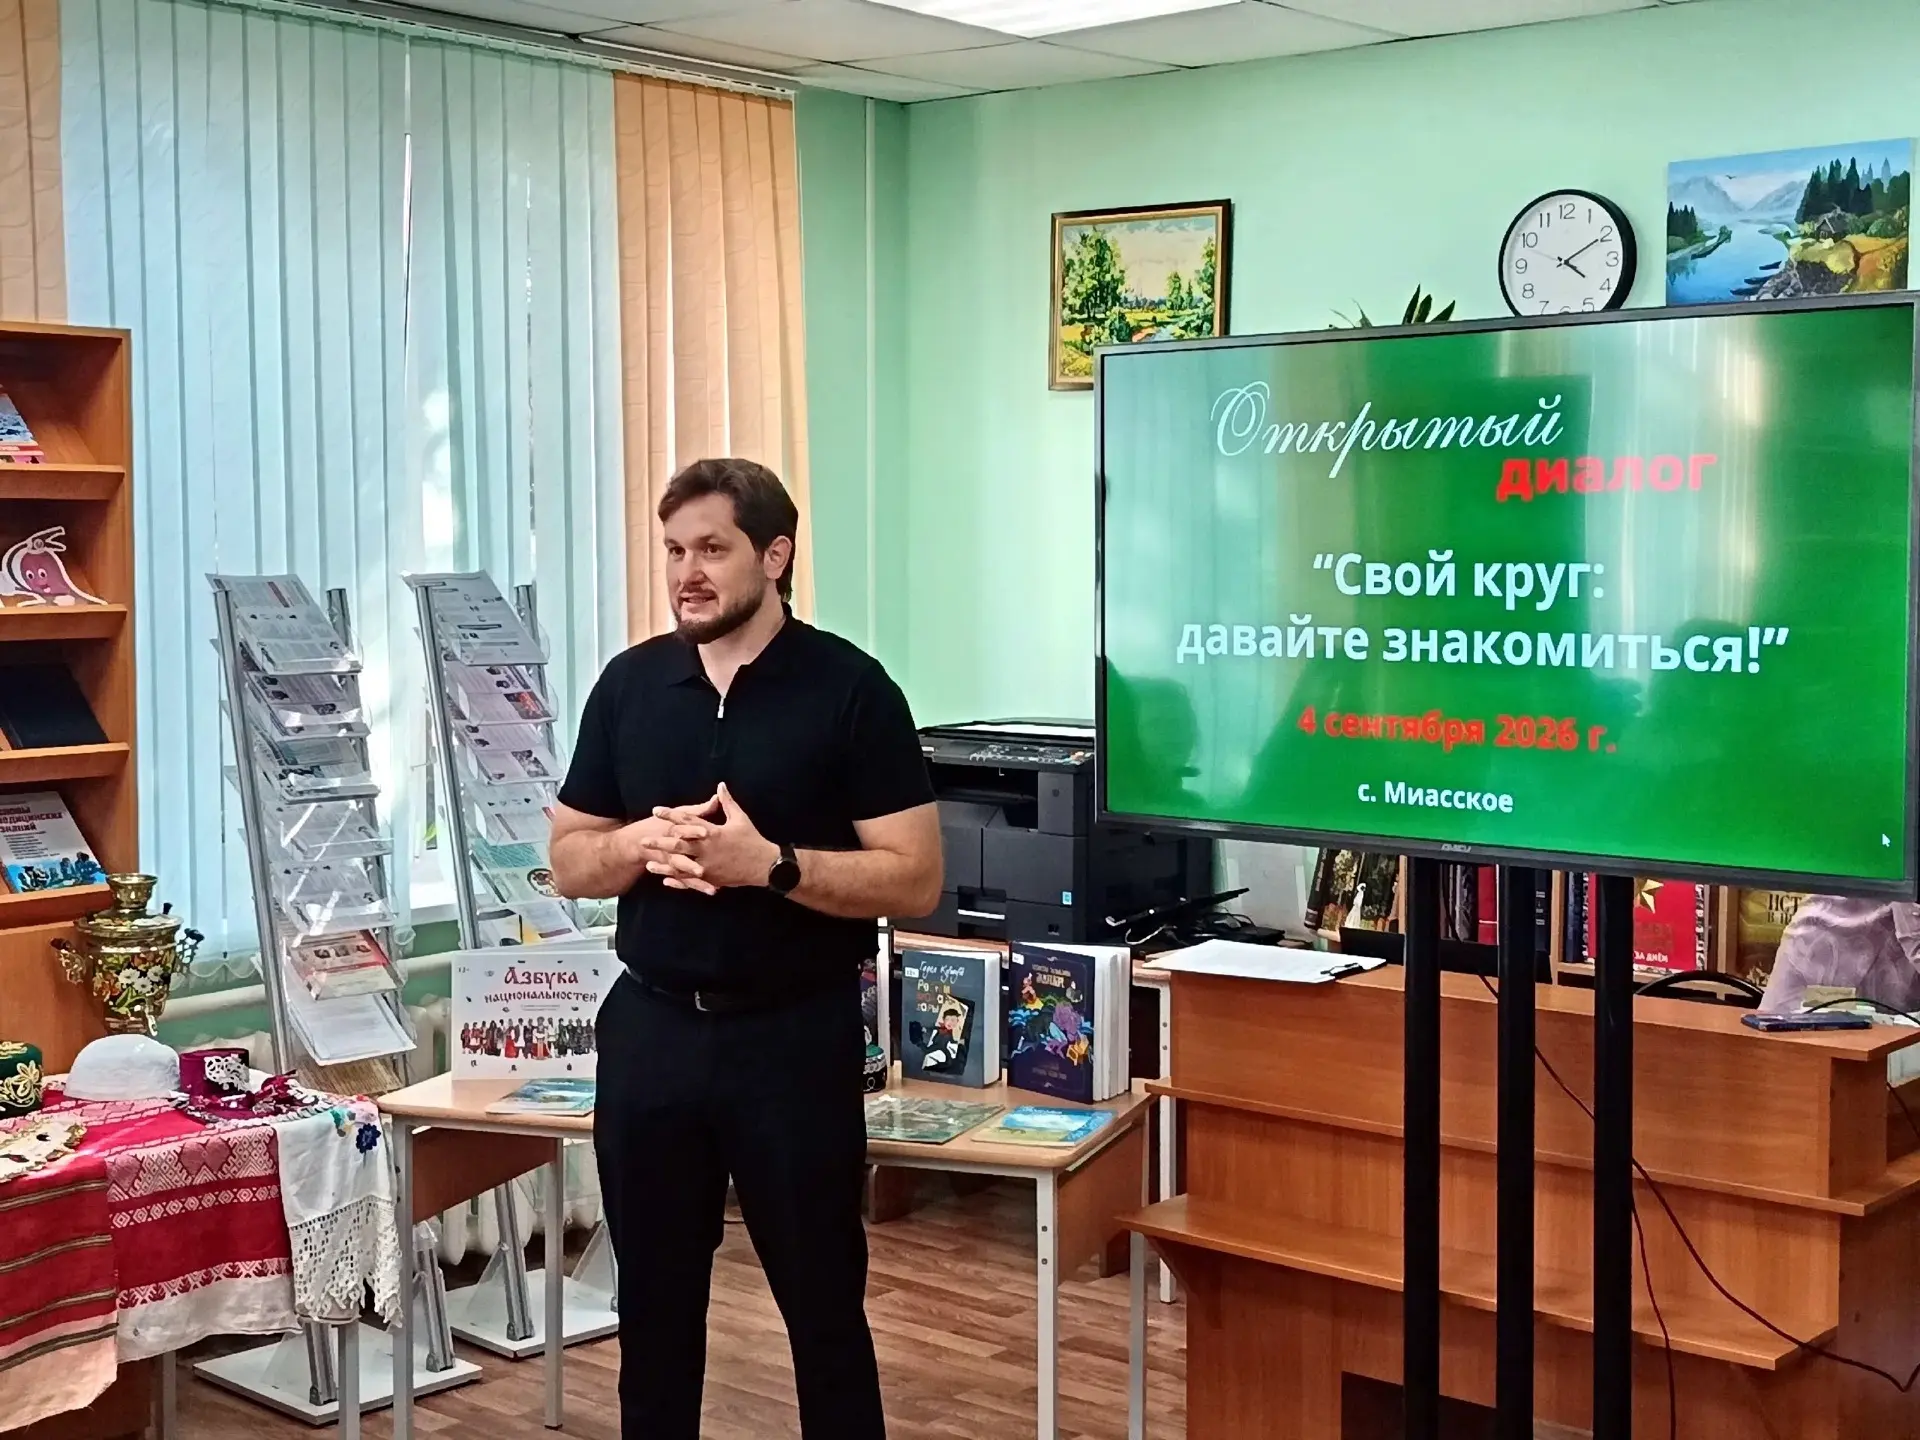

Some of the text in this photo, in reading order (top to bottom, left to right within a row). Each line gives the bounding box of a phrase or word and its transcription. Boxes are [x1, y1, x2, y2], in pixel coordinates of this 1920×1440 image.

[1559, 203, 1576, 219] 12
[1587, 208, 1592, 224] 1
[1539, 212, 1551, 228] 11
[1522, 232, 1538, 248] 10
[1600, 225, 1613, 242] 2
[1515, 258, 1528, 274] 9
[1605, 251, 1619, 267] 3
[1522, 283, 1535, 299] 8
[1599, 278, 1612, 292] 4
[1539, 300, 1550, 315] 7
[1210, 380, 1564, 478] Открытый
[1496, 454, 1718, 502] диалог
[1313, 549, 1605, 612] “Свой круг:
[1176, 613, 1790, 674] давайте знакомиться!”
[1297, 705, 1617, 753] 4 сентября 2026 г.
[1357, 780, 1514, 813] с. Миасское
[0, 813, 62, 824] ЕДИЦИНСКИХ
[1768, 893, 1802, 914] ИСТ
